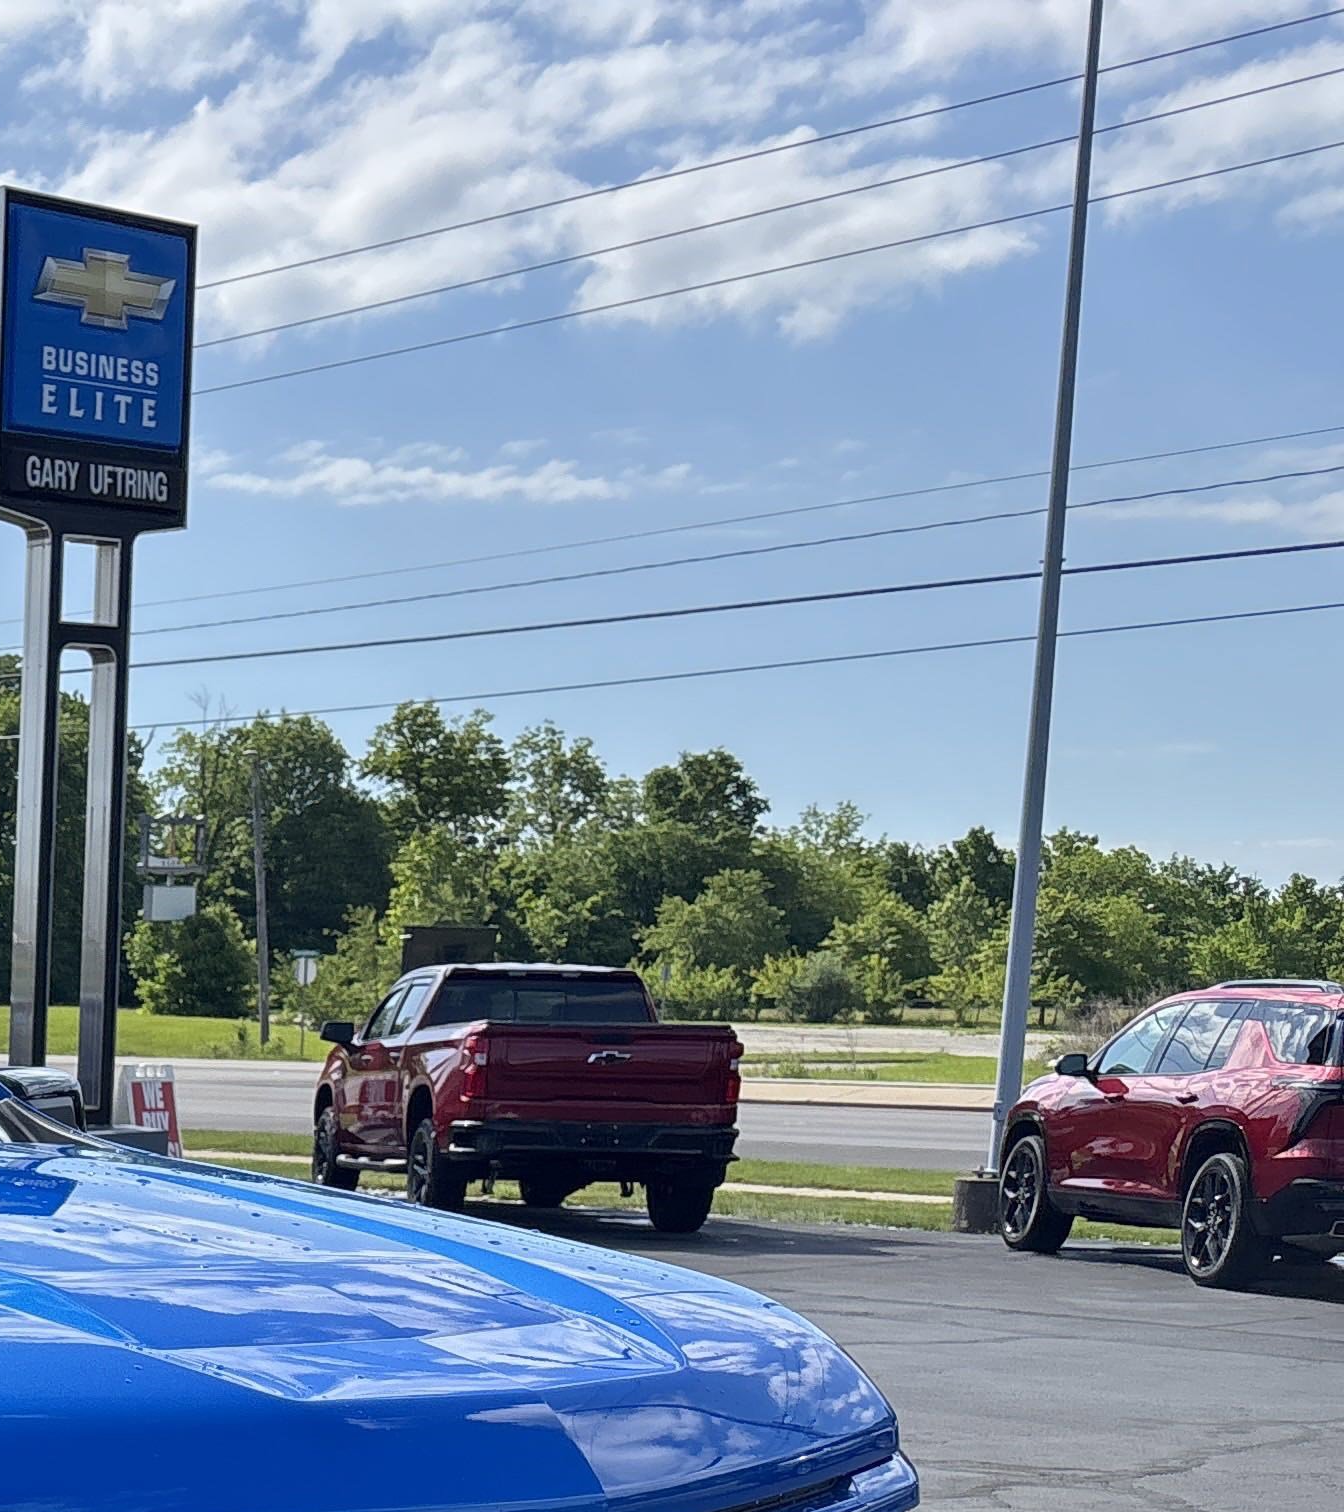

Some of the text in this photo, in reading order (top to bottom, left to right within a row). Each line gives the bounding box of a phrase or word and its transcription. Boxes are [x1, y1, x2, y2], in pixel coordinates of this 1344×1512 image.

[42, 346, 159, 387] BUSINESS
[41, 384, 157, 428] ELITE
[26, 455, 168, 502] GARY UFTRING
[141, 1081, 164, 1109] WE
